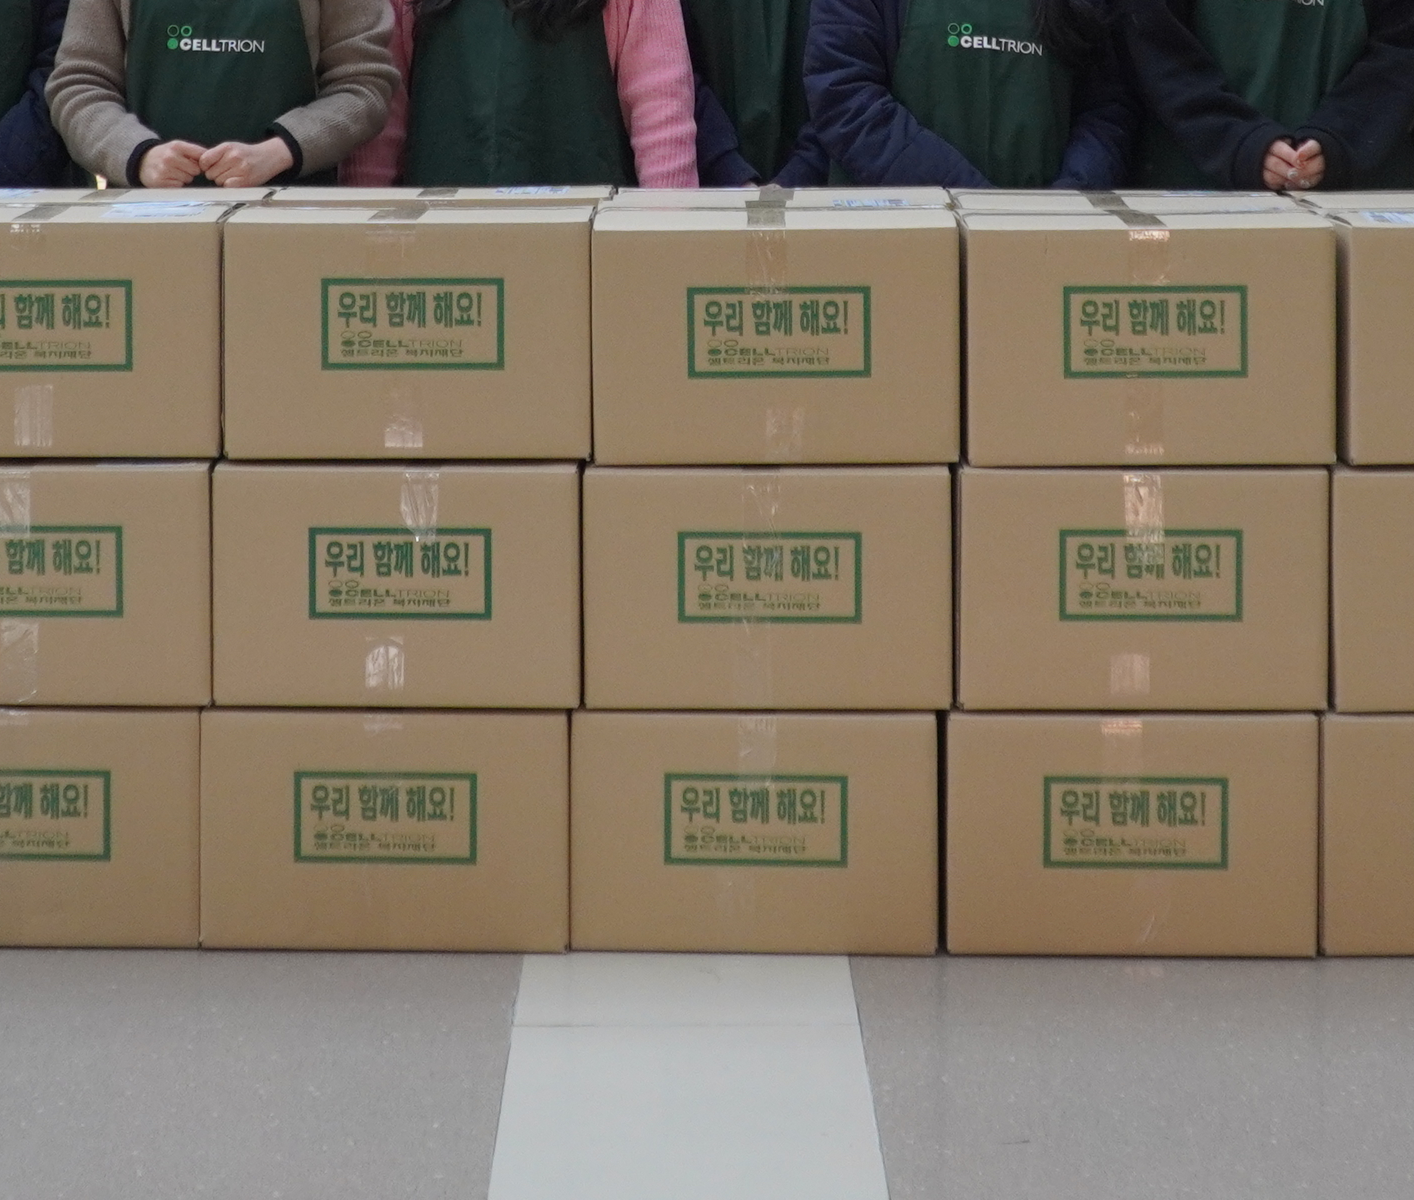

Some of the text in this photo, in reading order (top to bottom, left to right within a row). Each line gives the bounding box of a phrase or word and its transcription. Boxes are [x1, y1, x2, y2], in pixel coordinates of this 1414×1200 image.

[179, 38, 265, 53] CELLTRION
[960, 34, 1043, 57] CELLTRION
[14, 293, 55, 330] 함께
[62, 293, 111, 330] 해요!
[337, 291, 483, 328] 우리 함께 해요!
[703, 300, 849, 336] 우리 함께 해요!
[1078, 299, 1225, 336] 우리 함께 해요!
[6, 539, 47, 576] 함께
[53, 539, 102, 576] 해요!
[325, 540, 471, 577] 우리 함께 해요!
[693, 545, 733, 582] 우리
[790, 545, 840, 582] 해요!
[1075, 543, 1115, 580] 우리
[1171, 543, 1221, 580] 해요!
[40, 782, 89, 818] 해요!
[310, 785, 456, 822] 우리 함께 해요!
[680, 787, 826, 824] 우리 함께 해요!
[1059, 790, 1206, 826] 우리 함께 해요!
